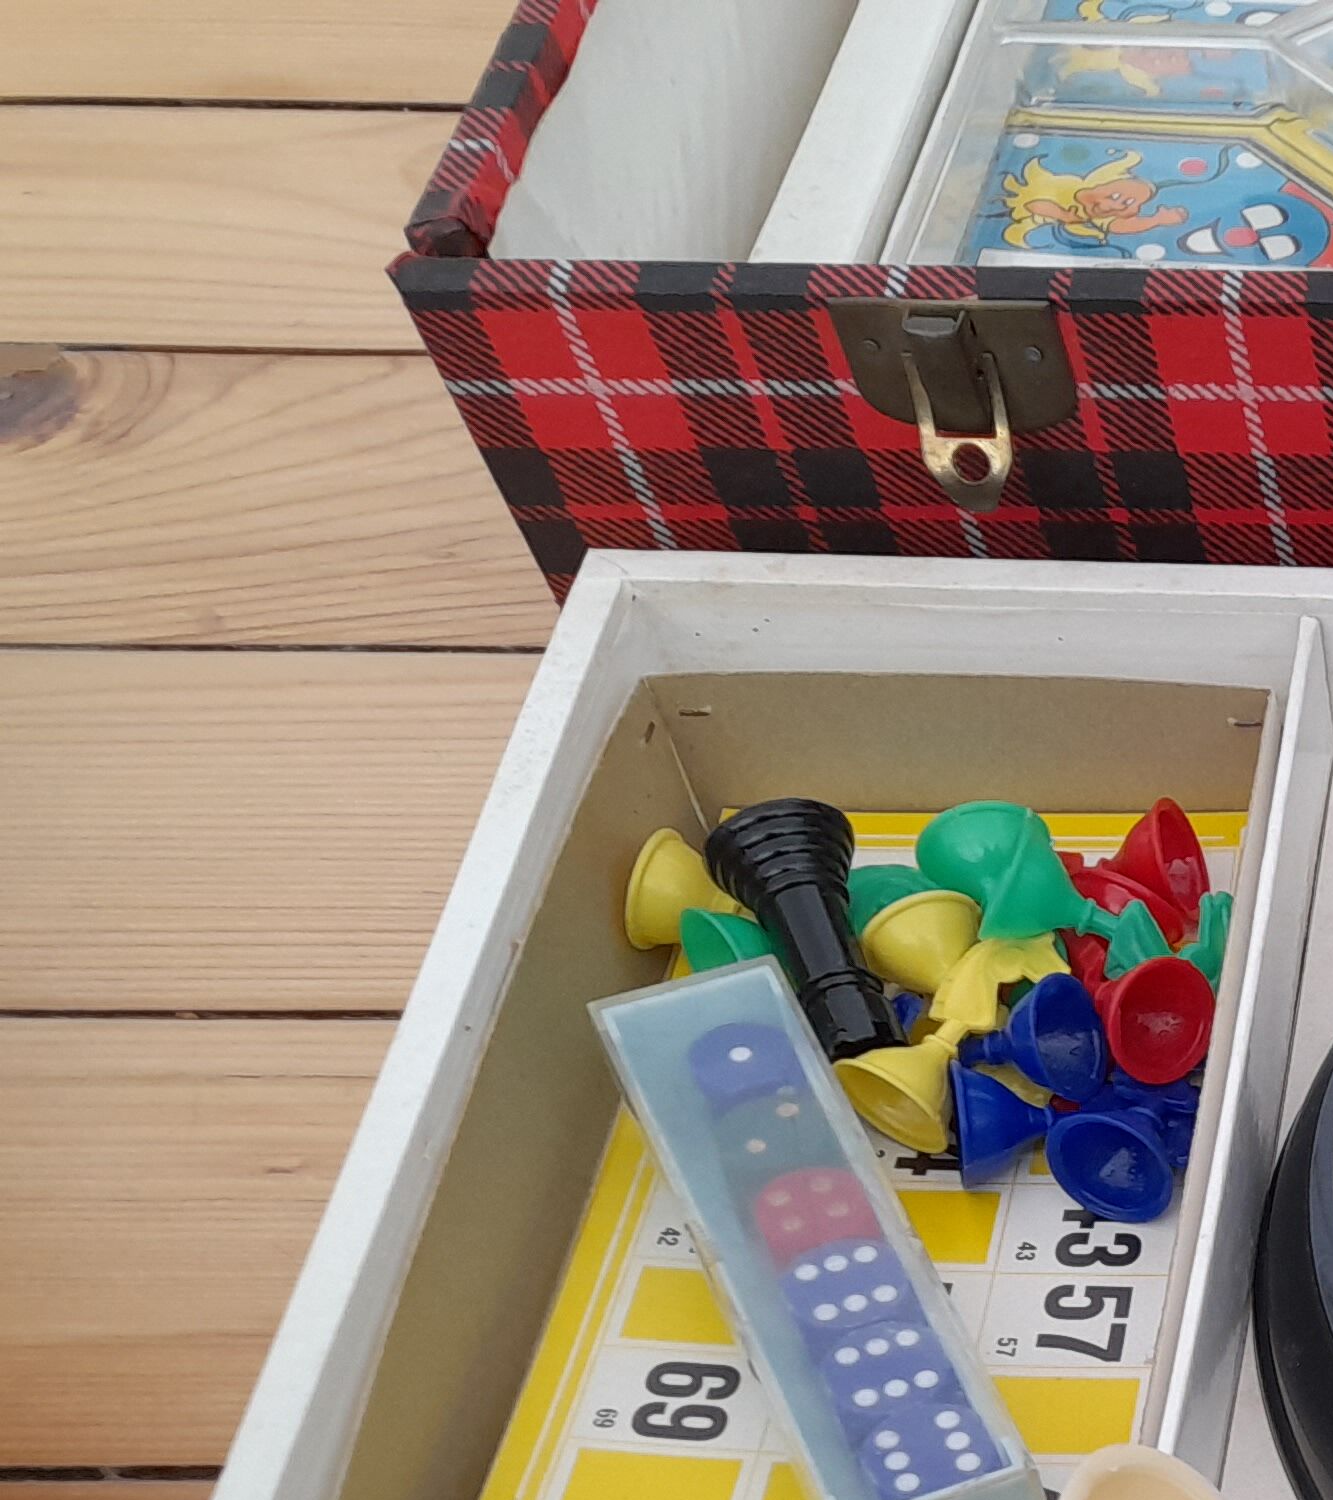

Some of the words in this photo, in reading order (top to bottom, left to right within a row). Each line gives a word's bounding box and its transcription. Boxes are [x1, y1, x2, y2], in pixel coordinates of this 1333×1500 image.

[657, 1227, 681, 1246] 42
[1014, 1240, 1037, 1262] 43
[1035, 1284, 1134, 1363] 57
[995, 1336, 1018, 1358] 57
[631, 1361, 742, 1441] 69
[592, 1408, 619, 1429] 69
